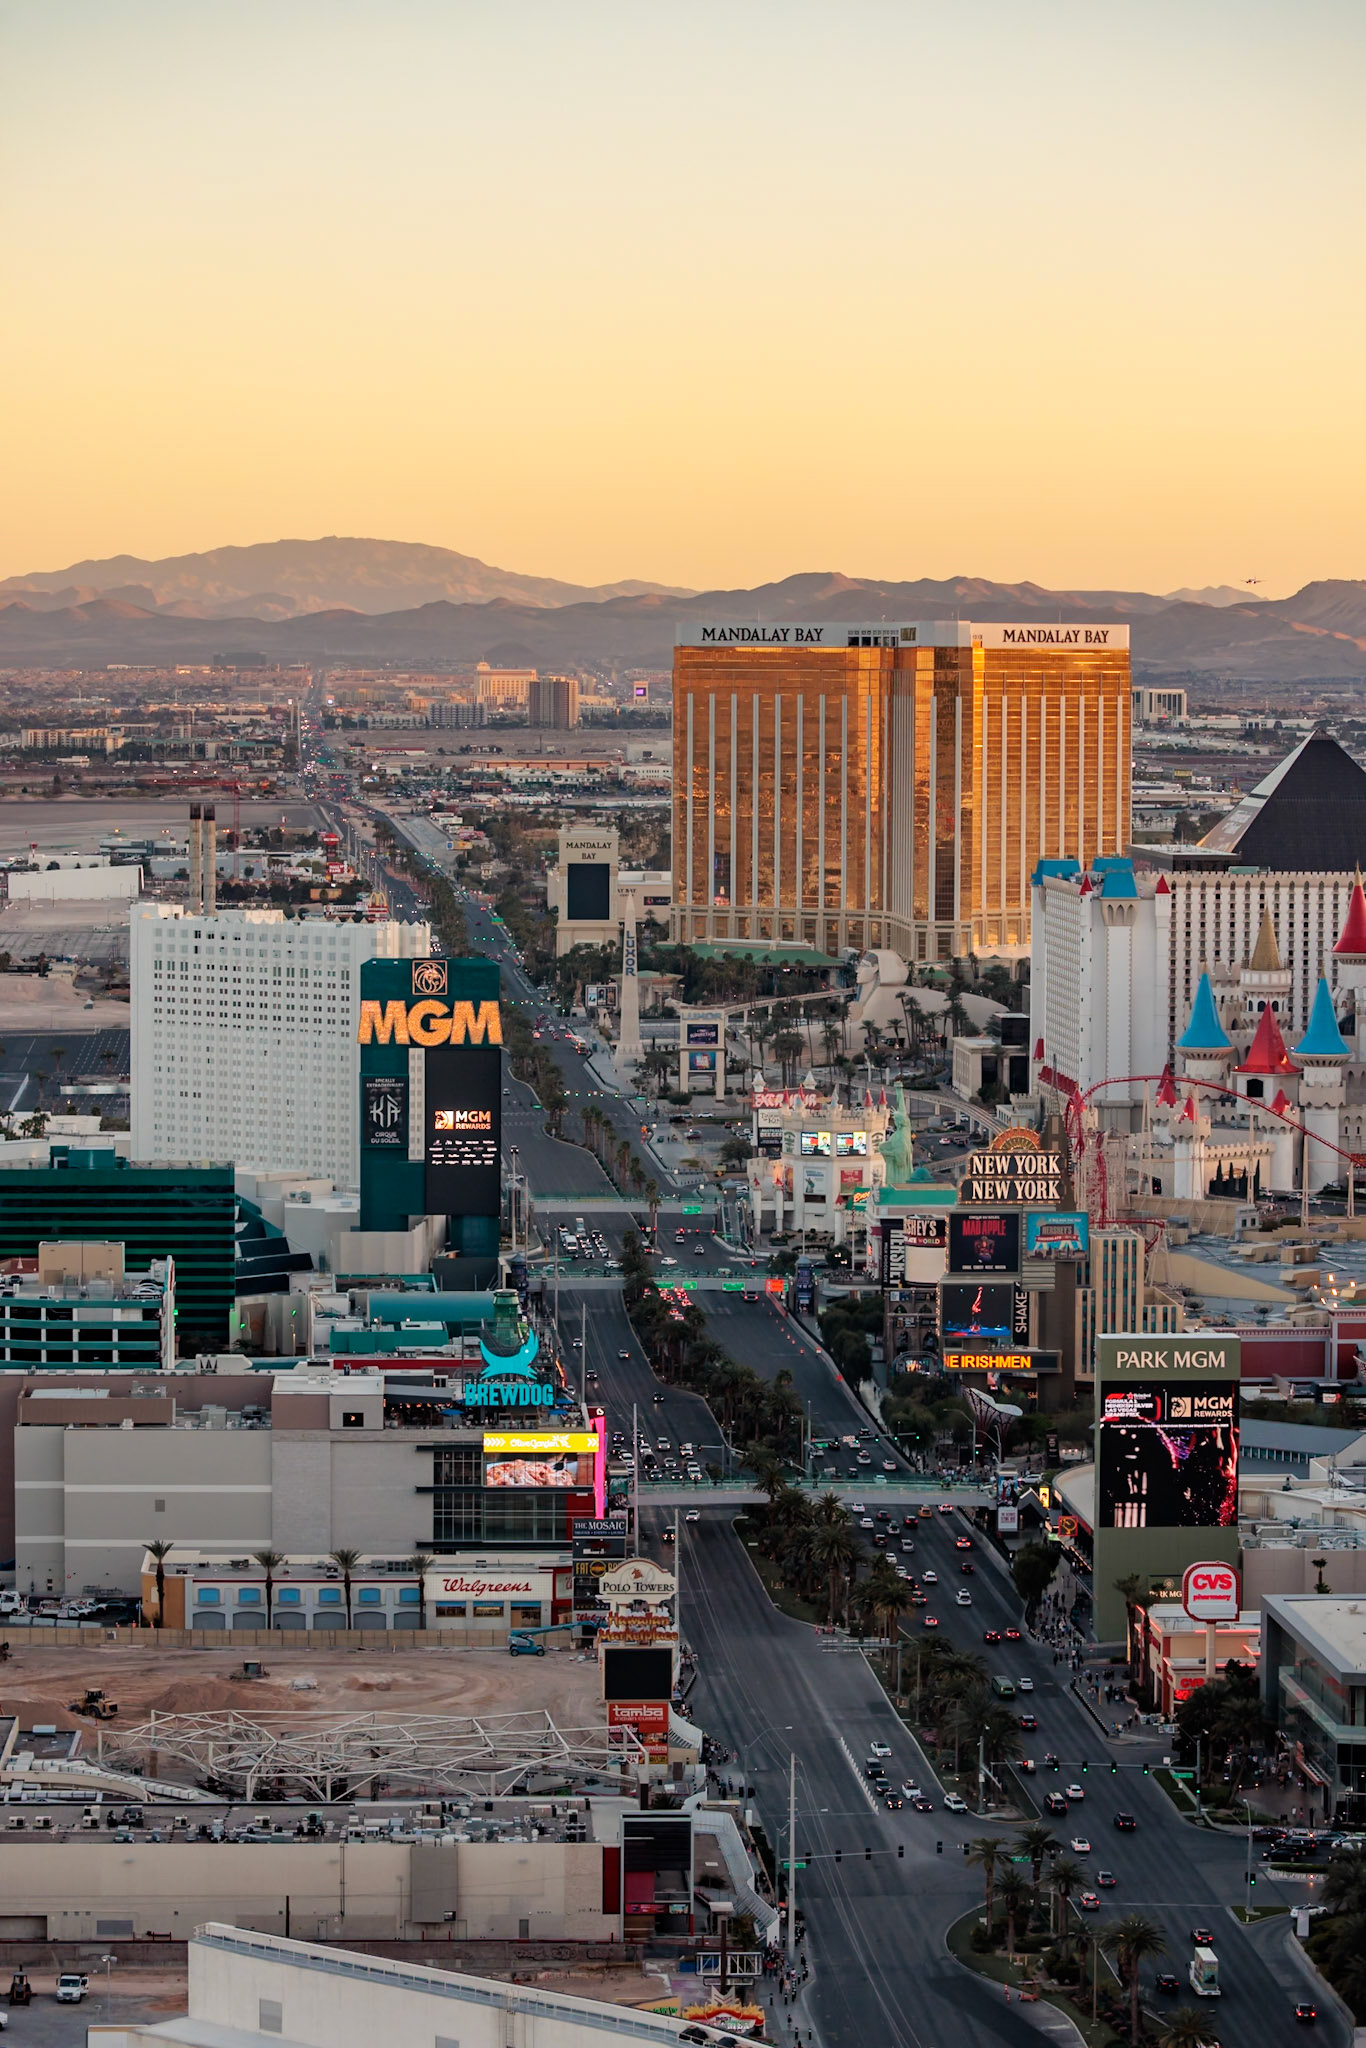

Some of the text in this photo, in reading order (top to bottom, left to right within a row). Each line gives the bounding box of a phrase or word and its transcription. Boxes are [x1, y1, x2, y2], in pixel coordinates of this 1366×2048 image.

[701, 627, 824, 642] MANDALAY BAY
[1002, 629, 1109, 643] MANDALAY BAY
[625, 930, 636, 976] LUXOR
[357, 1000, 503, 1047] MGM
[455, 1110, 491, 1122] MGM
[972, 1155, 1060, 1174] NEW YORK
[972, 1180, 1060, 1200] NEW YORK
[962, 1220, 1007, 1236] MAD APPLE
[1015, 1291, 1027, 1333] SHAKE
[960, 1355, 1031, 1368] IRISHMEN
[1116, 1350, 1226, 1368] PARK MGM
[464, 1383, 554, 1406] BREWDOG
[1194, 1397, 1233, 1409] MGM
[1194, 1410, 1233, 1418] REWARDS
[510, 1438, 559, 1449] Olive Garden
[588, 1521, 625, 1530] MOSAIC
[576, 1562, 589, 1574] FAT
[443, 1577, 533, 1597] Walgreens
[602, 1582, 675, 1592] POLO TOWERS
[1192, 1573, 1233, 1590] CVS
[1193, 1593, 1232, 1602] pharmacy
[608, 1611, 670, 1626] Hawaiian
[597, 1627, 678, 1641] Marketplace
[612, 1704, 664, 1717] tamba
